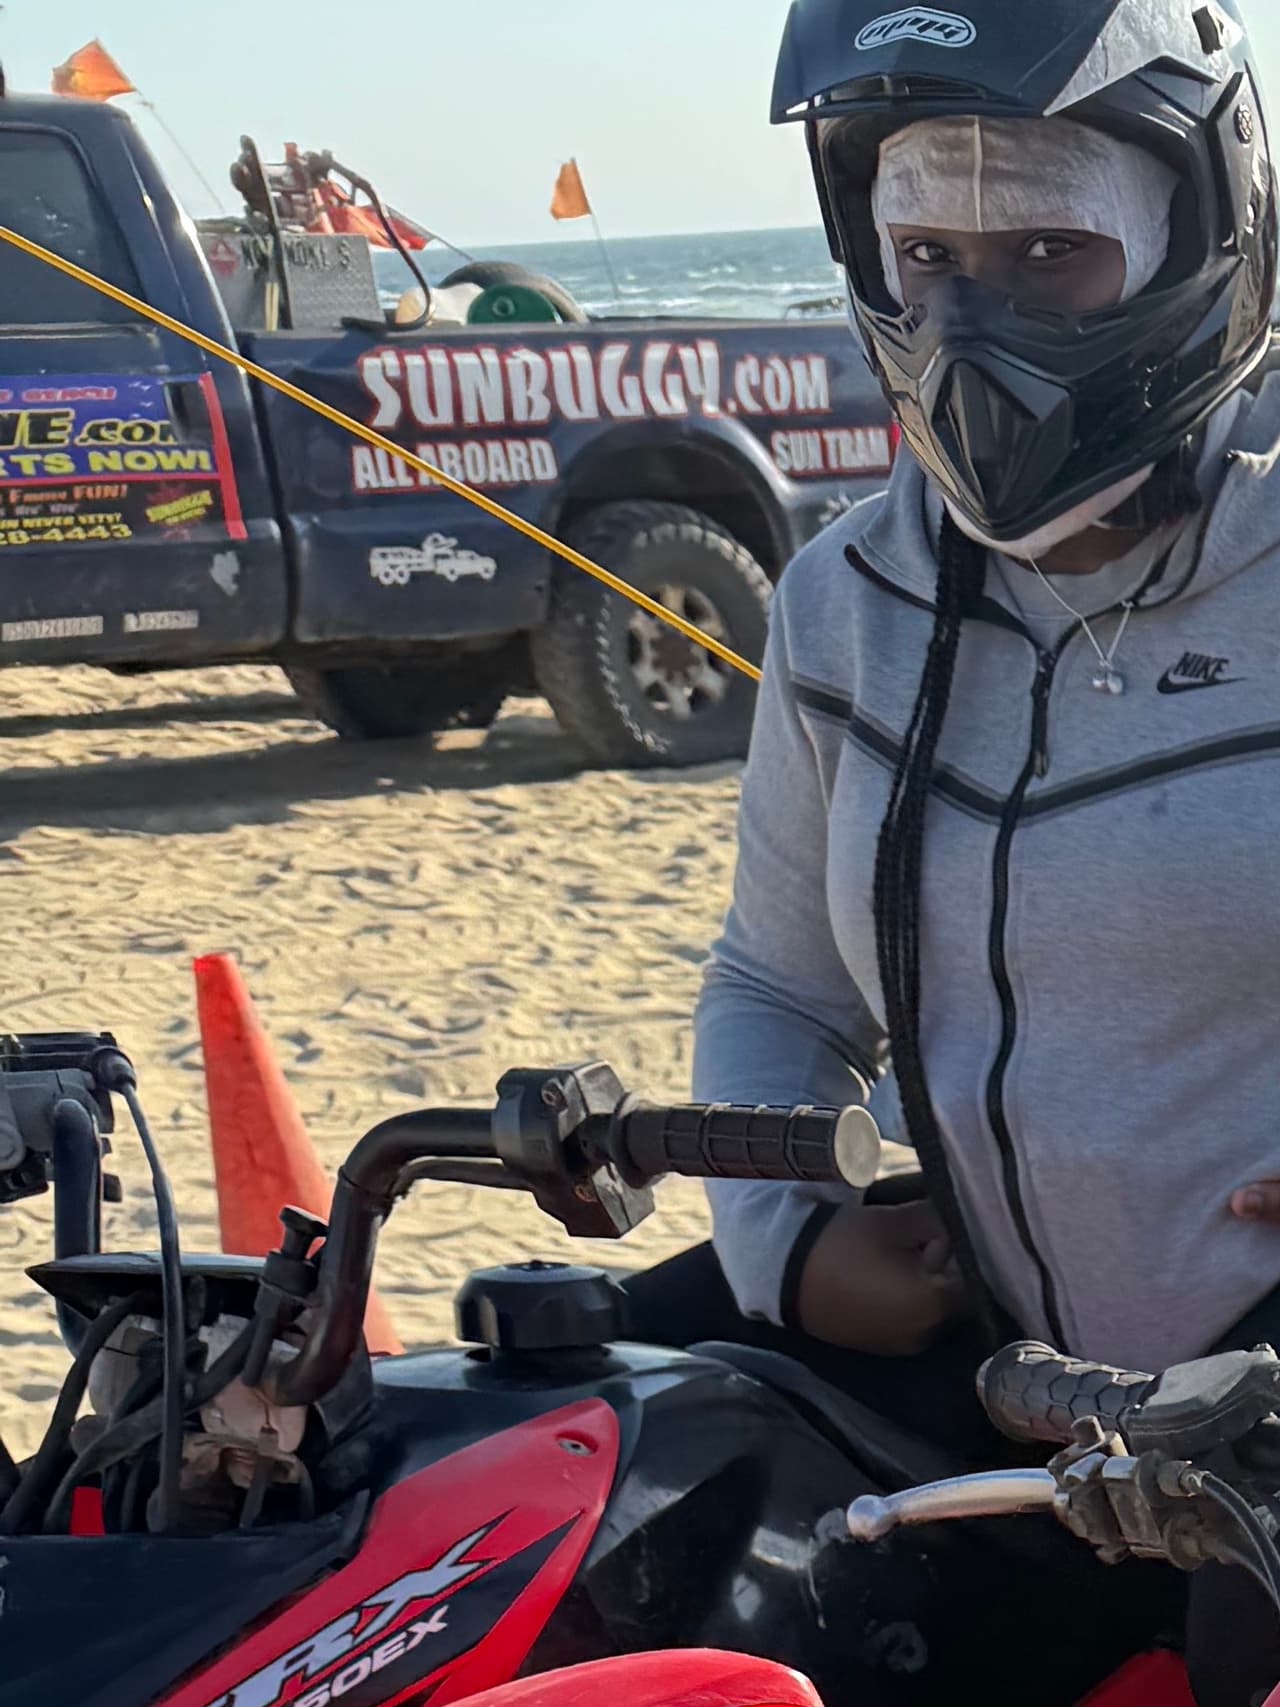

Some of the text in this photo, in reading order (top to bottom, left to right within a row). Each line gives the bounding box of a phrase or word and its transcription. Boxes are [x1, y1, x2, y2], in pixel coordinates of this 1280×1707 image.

[88, 450, 213, 472] NOW!
[352, 437, 558, 490] ALL ABOARD
[770, 427, 890, 472] SUN TRAM
[1173, 652, 1229, 680] NIKE
